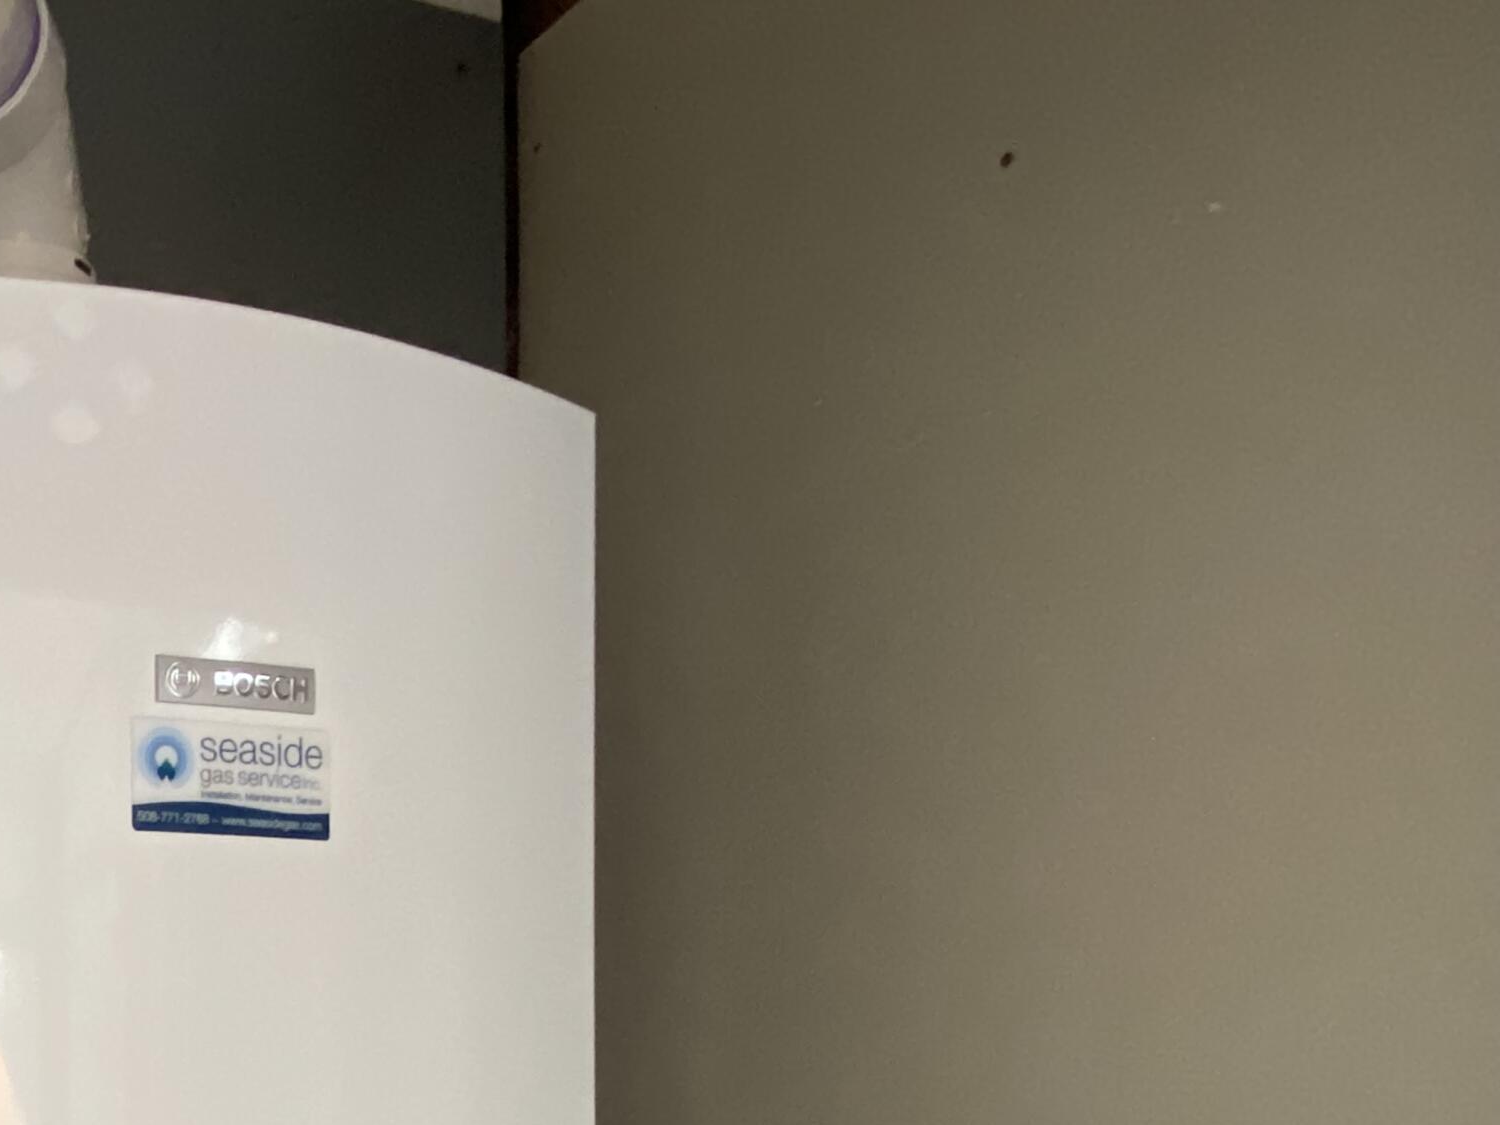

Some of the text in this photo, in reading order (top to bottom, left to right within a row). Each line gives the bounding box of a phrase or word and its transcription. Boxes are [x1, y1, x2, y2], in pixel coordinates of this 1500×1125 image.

[214, 670, 309, 704] BOSCH
[200, 735, 323, 770] seaside
[200, 767, 235, 789] gas
